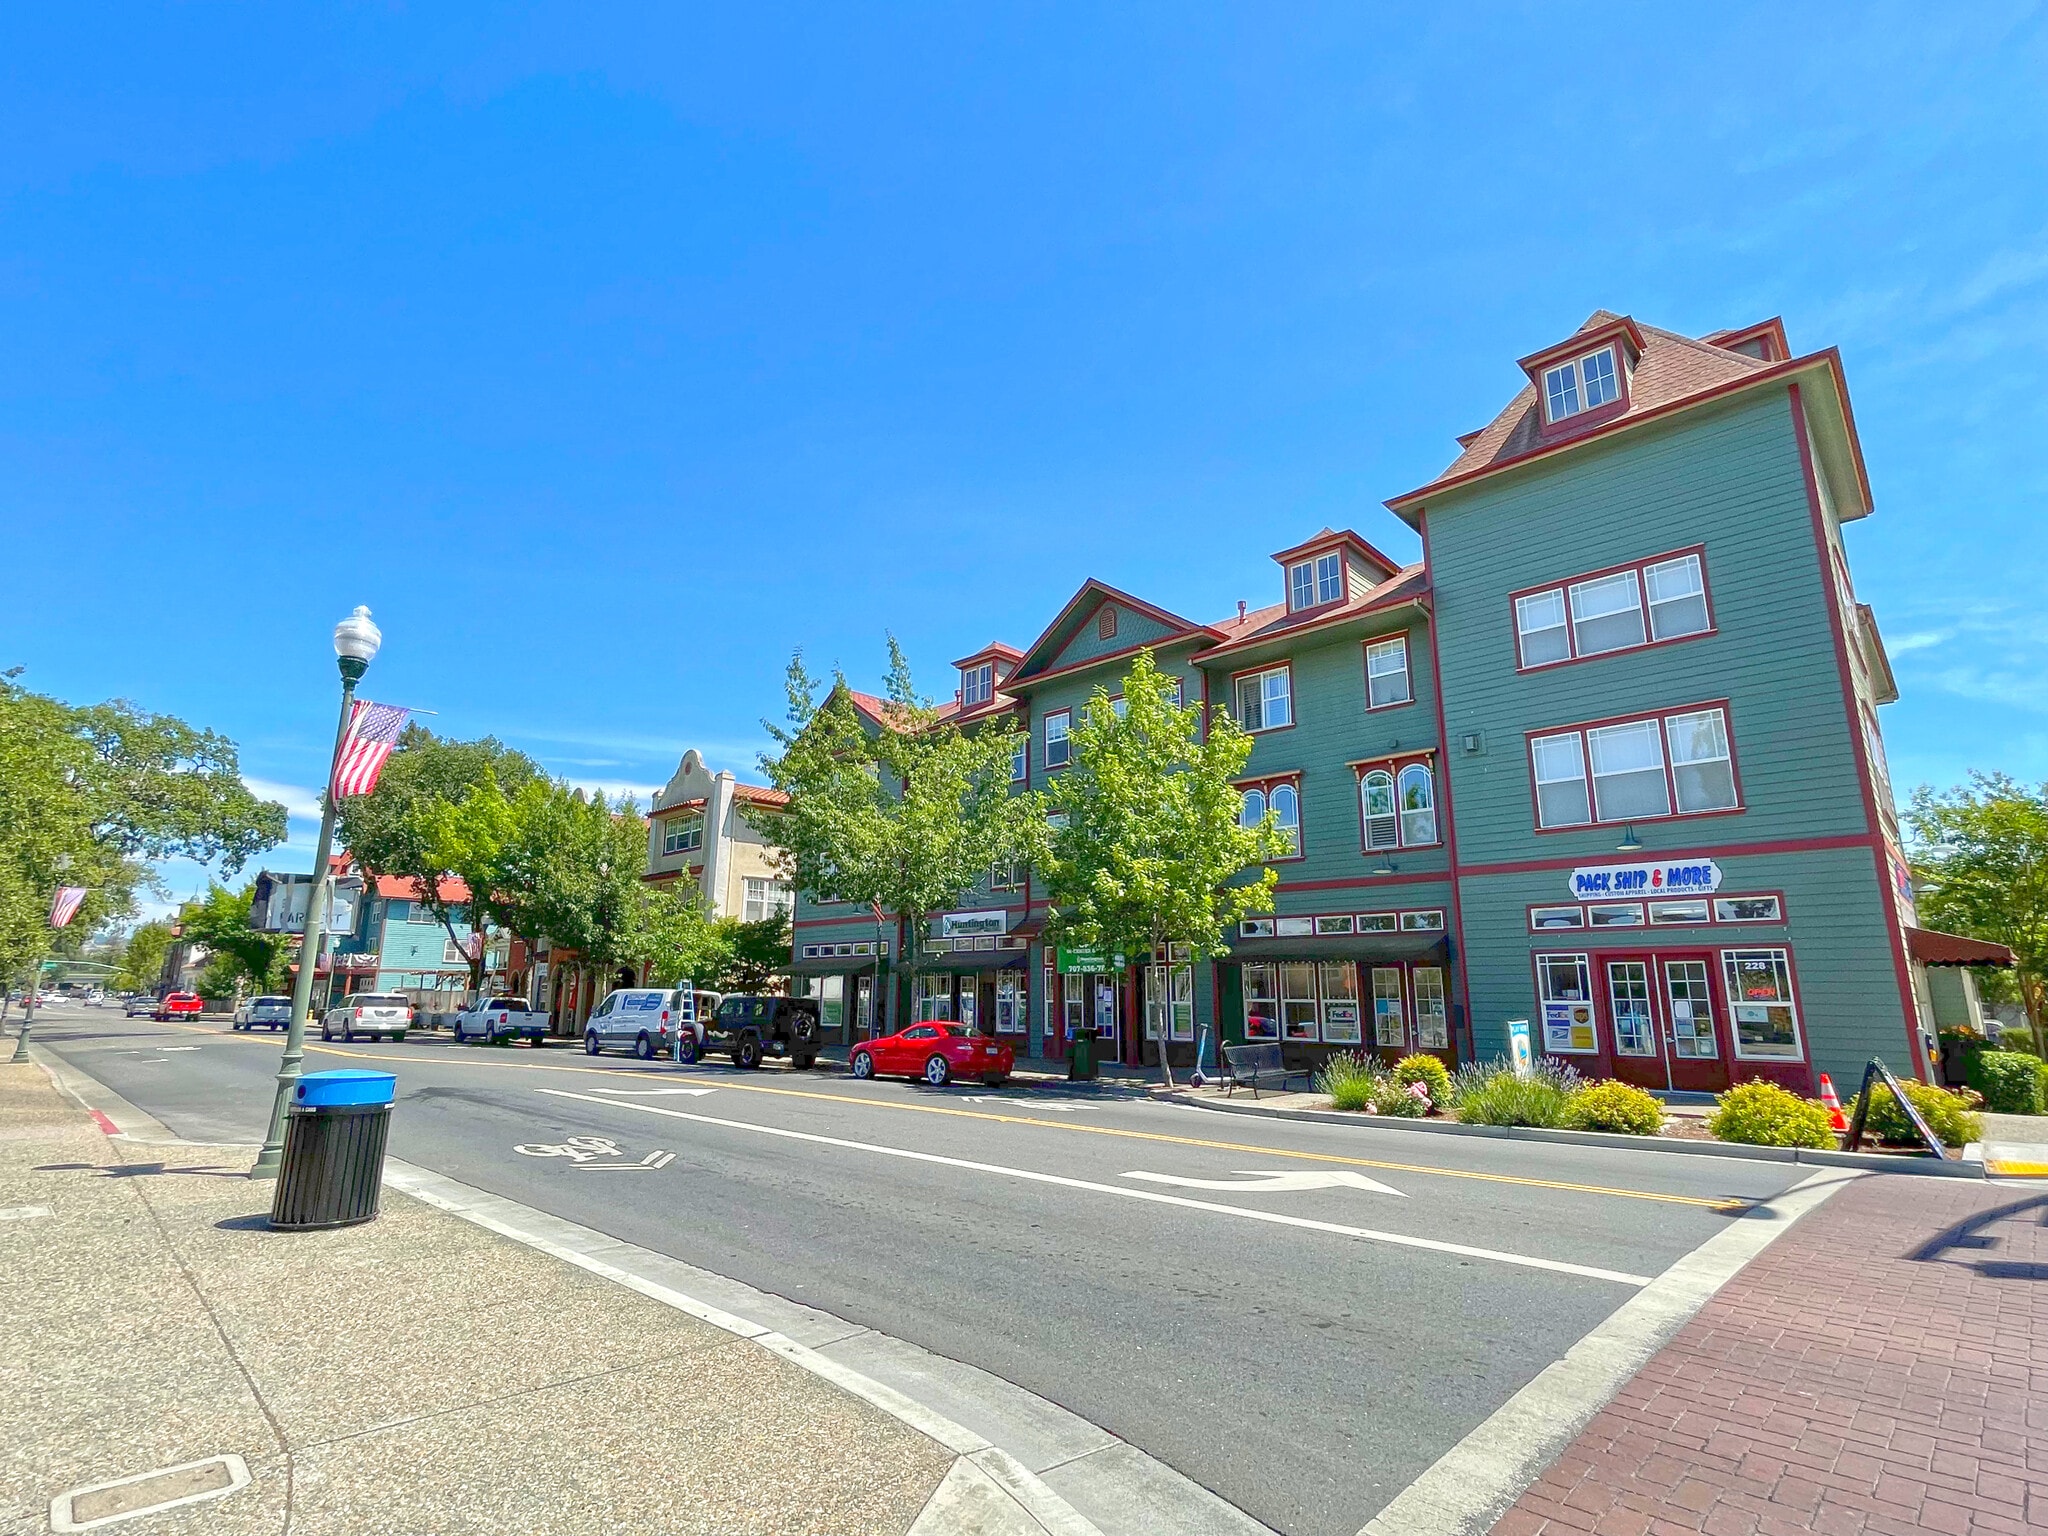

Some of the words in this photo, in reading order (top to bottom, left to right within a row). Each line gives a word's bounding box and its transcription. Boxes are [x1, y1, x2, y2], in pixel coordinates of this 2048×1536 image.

[1576, 873, 1611, 893] PACK
[1614, 870, 1648, 891] SHIP
[1651, 868, 1663, 888] &
[1667, 865, 1712, 887] MORE
[1650, 887, 1666, 895] LOCAL
[1667, 886, 1695, 894] PRODUCTS
[951, 919, 1000, 930] Huntington
[1745, 962, 1767, 970] 228
[1747, 986, 1777, 998] OPEN
